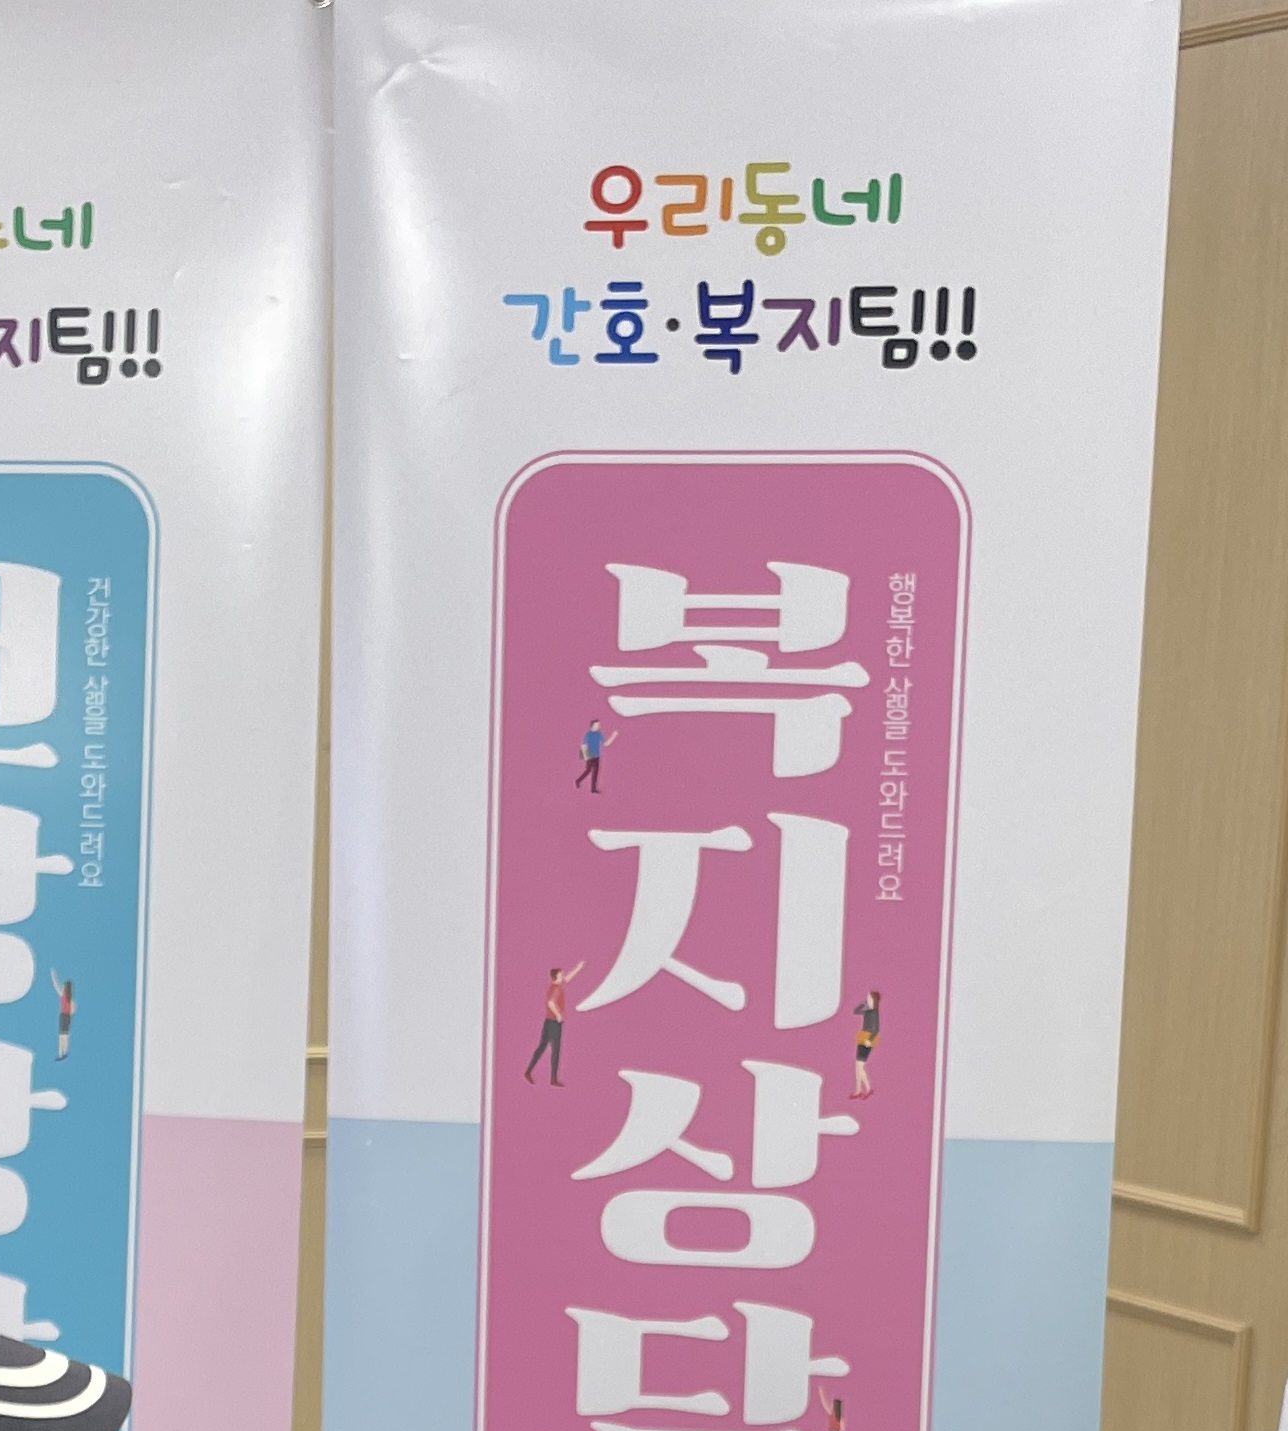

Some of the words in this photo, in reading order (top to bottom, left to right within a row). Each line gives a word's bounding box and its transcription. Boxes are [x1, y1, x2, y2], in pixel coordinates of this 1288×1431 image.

[583, 162, 903, 257] 우리동네
[84, 576, 112, 668] 건강한
[885, 572, 916, 668] 행복한
[82, 675, 110, 736] 삶을
[881, 677, 914, 741] 삶을
[76, 744, 108, 888] 도와드려요
[874, 750, 910, 902] 도와드려요
